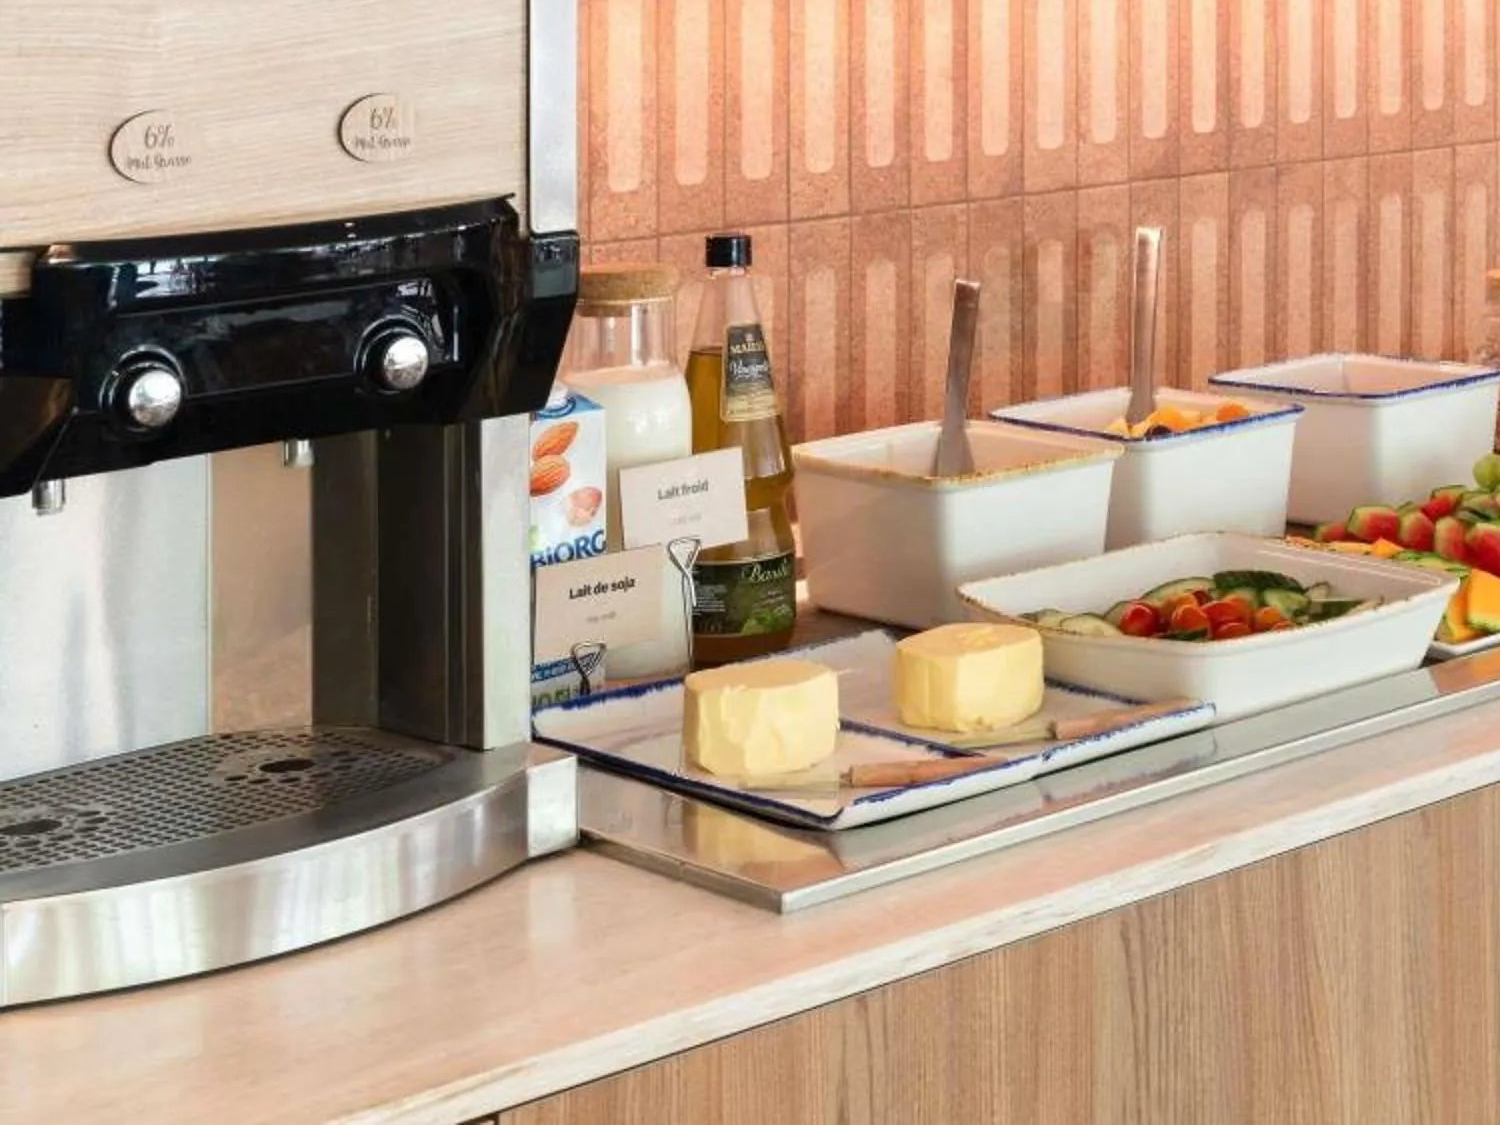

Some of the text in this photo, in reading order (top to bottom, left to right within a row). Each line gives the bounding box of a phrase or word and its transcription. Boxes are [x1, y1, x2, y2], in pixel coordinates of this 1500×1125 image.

[370, 106, 399, 129] 6%
[144, 124, 175, 149] 6%
[657, 479, 708, 500] Lait froid
[568, 576, 636, 600] Lait de soja
